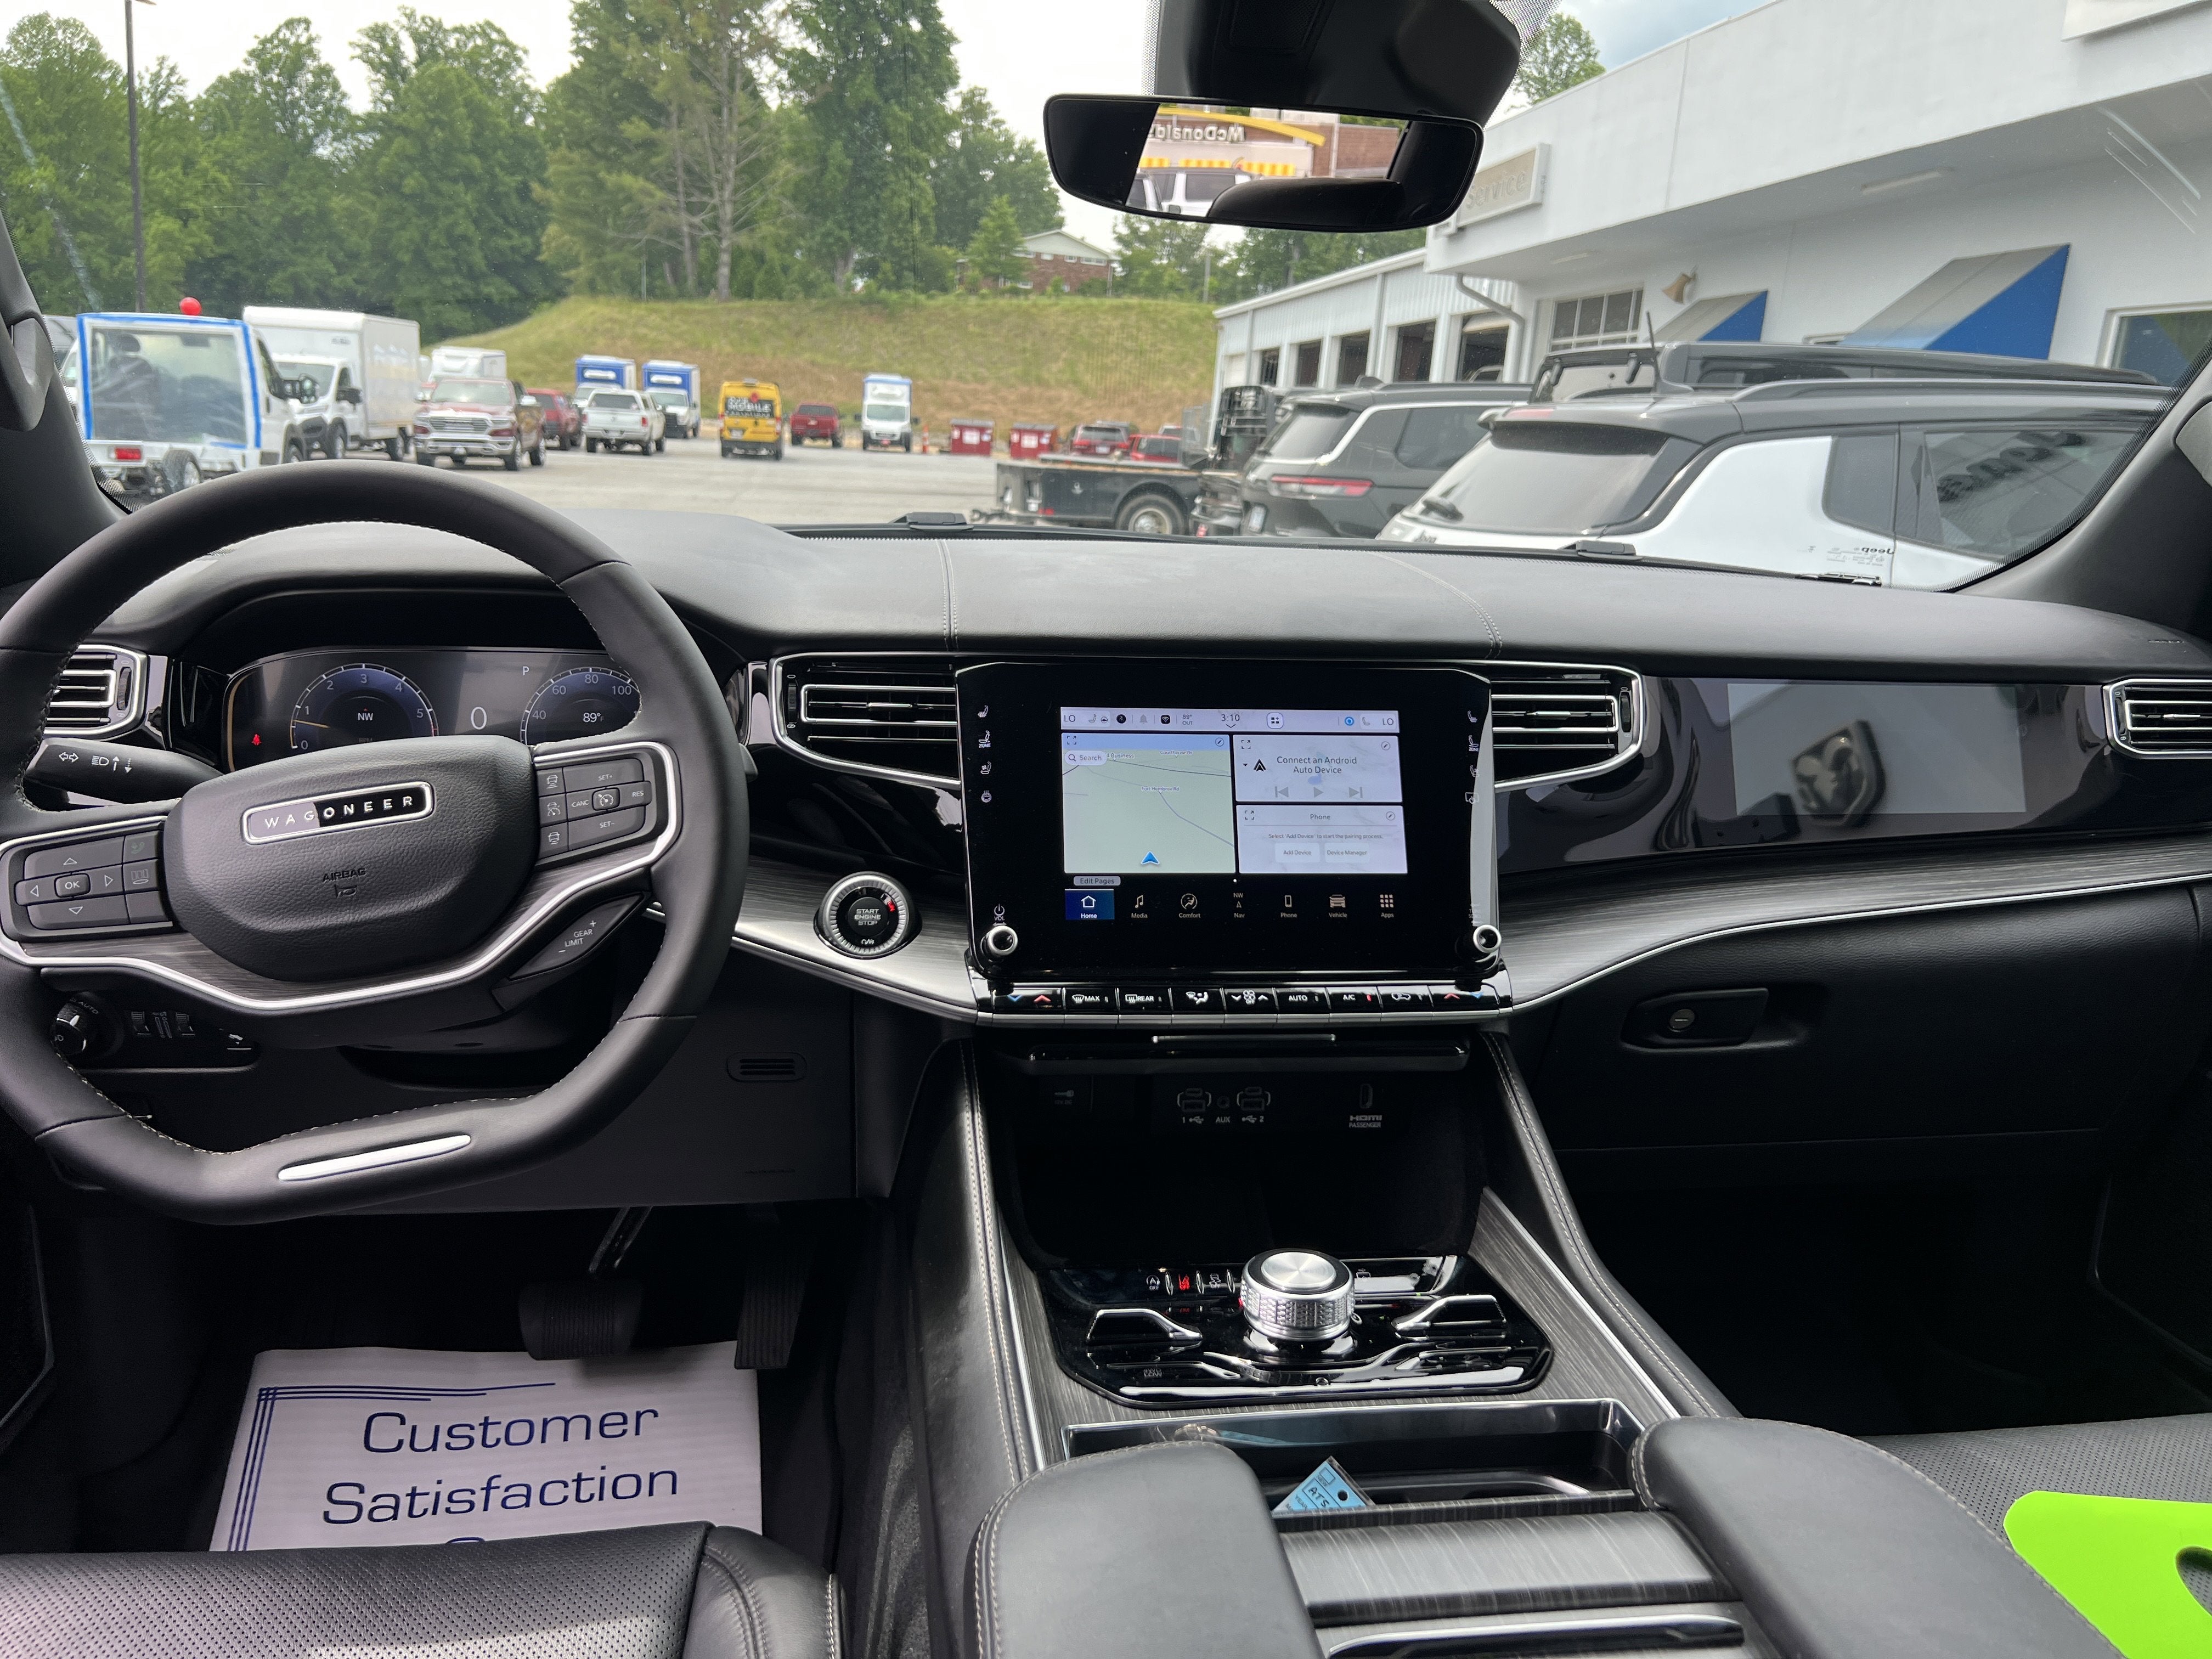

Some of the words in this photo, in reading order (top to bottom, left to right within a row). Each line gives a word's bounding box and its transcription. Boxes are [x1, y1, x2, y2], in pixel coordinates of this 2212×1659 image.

[1464, 171, 1527, 209] Service
[523, 666, 529, 675] P
[360, 674, 367, 684] 3
[585, 674, 599, 684] 80
[327, 681, 334, 690] 2
[395, 682, 403, 692] 4
[552, 685, 566, 695] 60
[612, 685, 632, 696] 100
[305, 705, 309, 715] 1
[416, 709, 424, 718] 5
[533, 710, 546, 720] 40
[358, 713, 374, 721] NW
[471, 707, 487, 730] 0
[1064, 714, 1076, 723] LO
[1221, 714, 1240, 722] 3:10
[301, 741, 308, 751] 0
[1277, 756, 1311, 764] Connect
[1324, 756, 1357, 765] Android
[572, 799, 590, 808] CANC
[264, 796, 413, 829] WAGONEER
[323, 868, 368, 882] AIRBAG
[65, 881, 80, 889] OK
[573, 929, 593, 938] GEAR
[565, 938, 583, 947] LIMIT
[78, 1001, 99, 1014] AUTO
[363, 1408, 659, 1454] Customer
[323, 1465, 678, 1525] Satisfaction
[1295, 1494, 1307, 1509] YEAR
